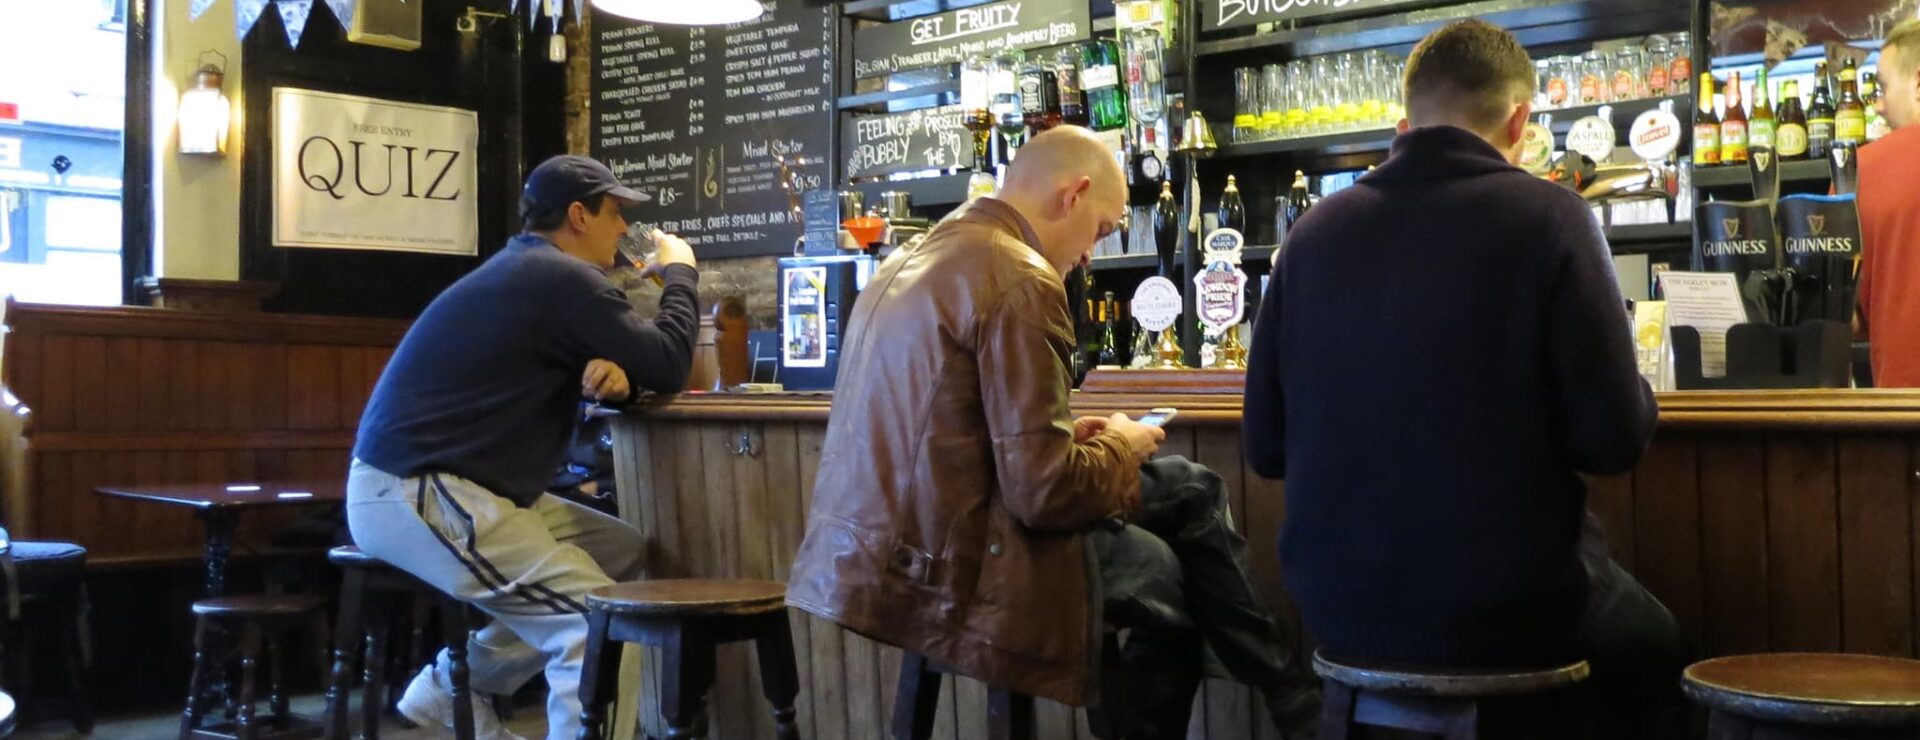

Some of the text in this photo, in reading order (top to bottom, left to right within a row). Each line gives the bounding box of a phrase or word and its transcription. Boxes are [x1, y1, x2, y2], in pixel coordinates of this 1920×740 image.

[911, 2, 1020, 42] GET FRUITY
[726, 31, 762, 46] VEGETABLE
[766, 24, 799, 38] TEMPURA
[855, 58, 891, 79] BELGIAN
[987, 37, 1005, 48] AND
[1049, 22, 1077, 45] BEERS
[750, 57, 765, 68] SALT
[725, 87, 741, 98] TOM
[353, 123, 413, 138] FREE ENTRY
[857, 115, 904, 144] FEELING
[924, 113, 964, 138] PROSECC
[743, 138, 803, 159] Mixed Starter
[863, 136, 910, 170] BUBBLY
[923, 146, 946, 167] THE
[298, 136, 461, 201] QUIZ
[668, 152, 694, 170] Starter
[663, 221, 679, 233] STIR
[731, 212, 766, 228] SPECIALS
[769, 211, 786, 223] AND
[1703, 240, 1767, 257] GUINNESS
[1785, 237, 1852, 254] GUINNESS
[1204, 282, 1239, 294] LONDON
[1206, 292, 1233, 303] PRIDE
